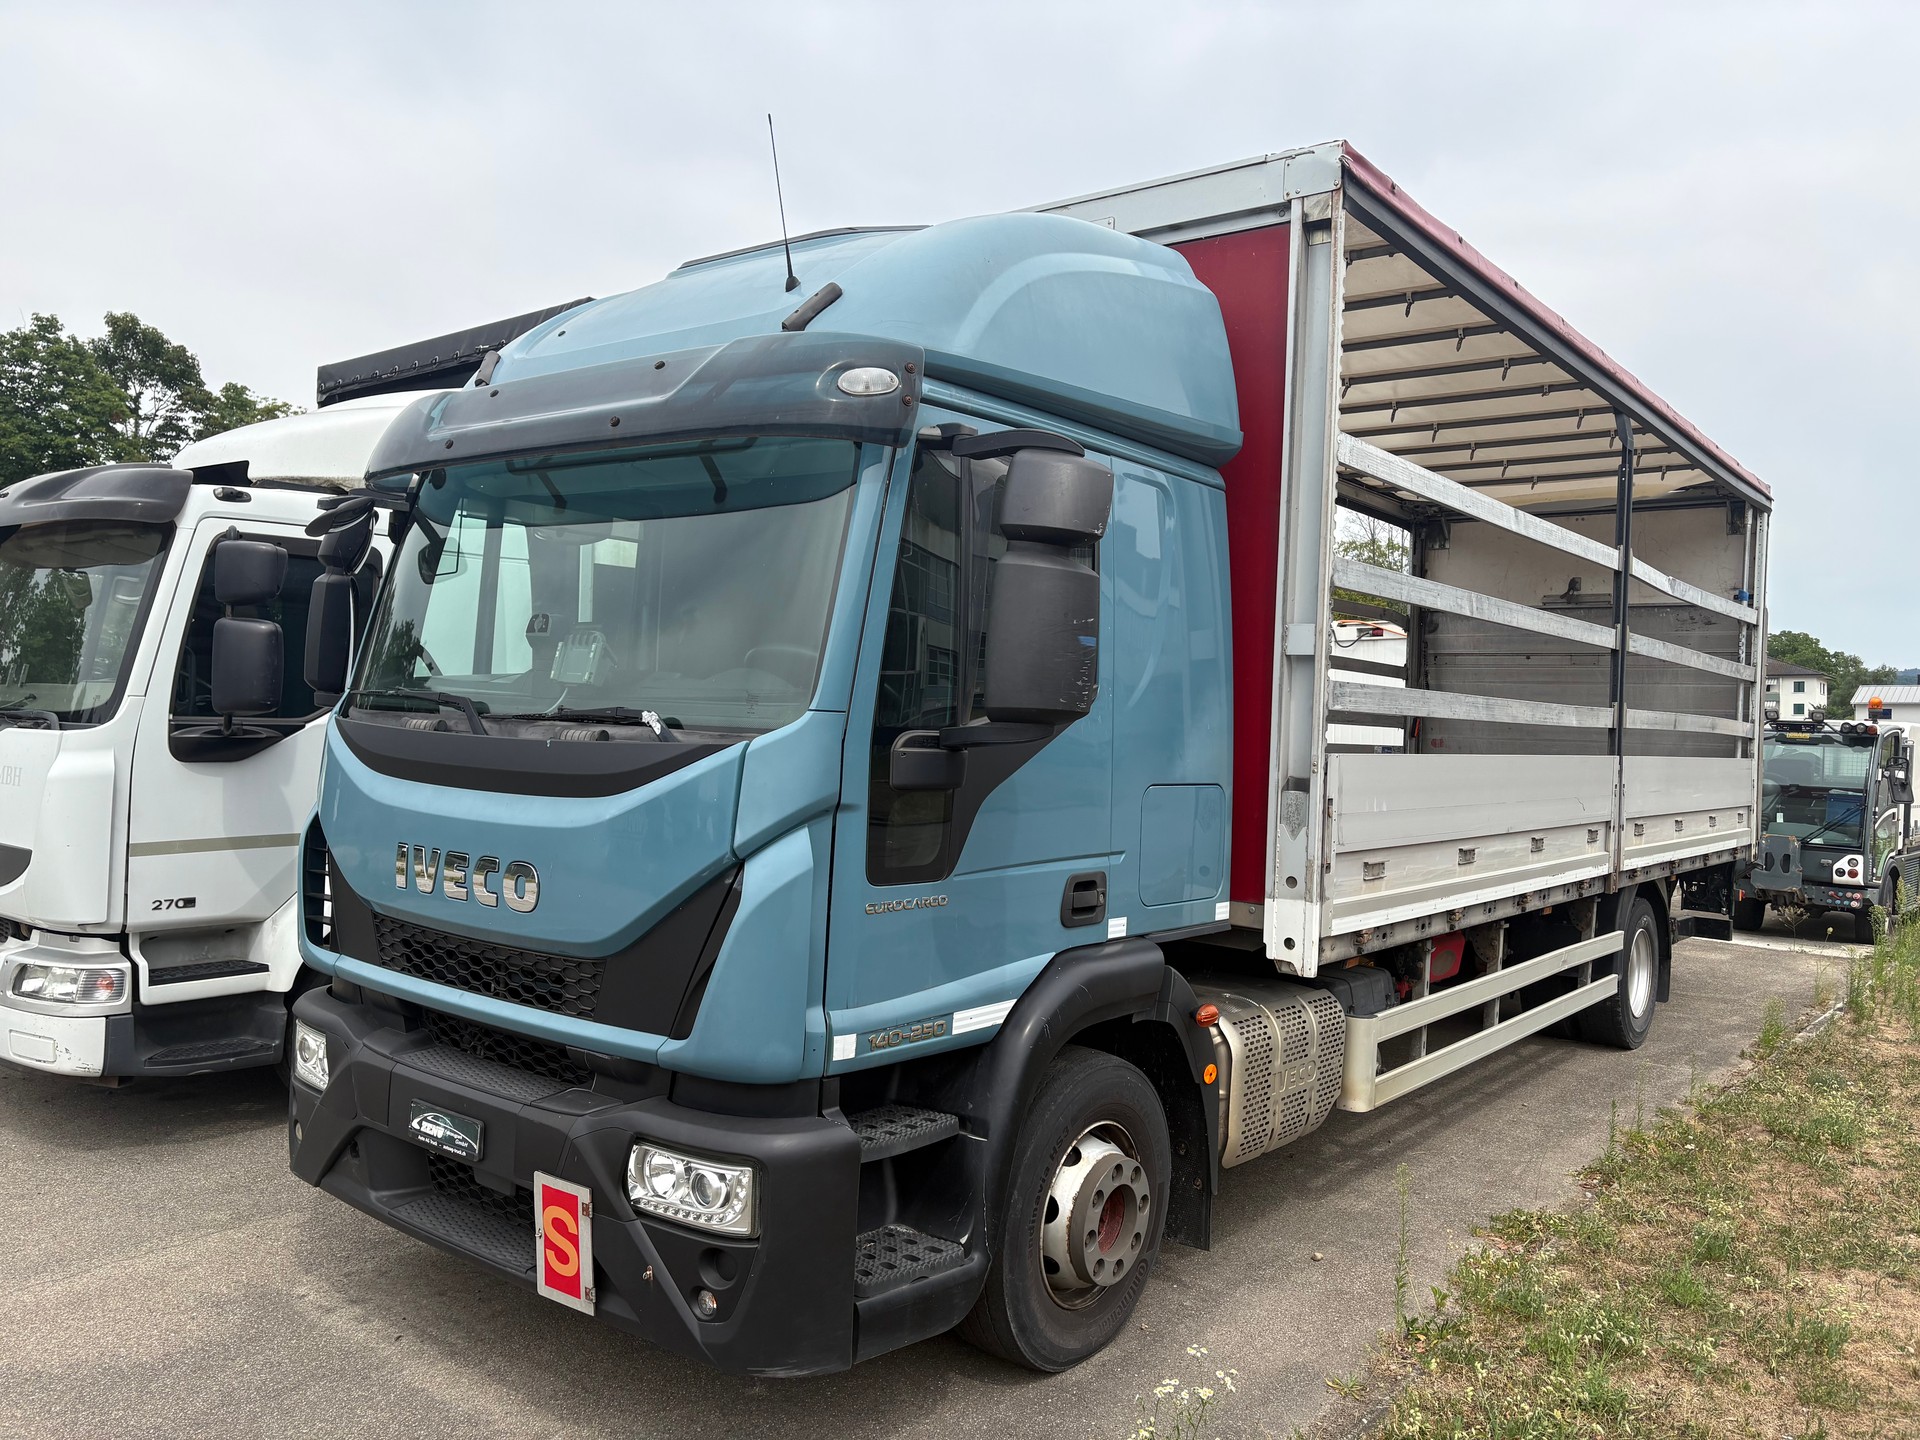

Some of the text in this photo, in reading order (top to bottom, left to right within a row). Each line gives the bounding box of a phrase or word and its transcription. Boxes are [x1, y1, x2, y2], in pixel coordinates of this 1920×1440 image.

[395, 842, 541, 914] IVECO
[865, 895, 949, 915] EUROCARGO
[868, 1020, 947, 1051] 140-250
[1271, 1060, 1317, 1096] IVECO
[455, 1139, 469, 1148] GmbH
[543, 1205, 579, 1277] S
